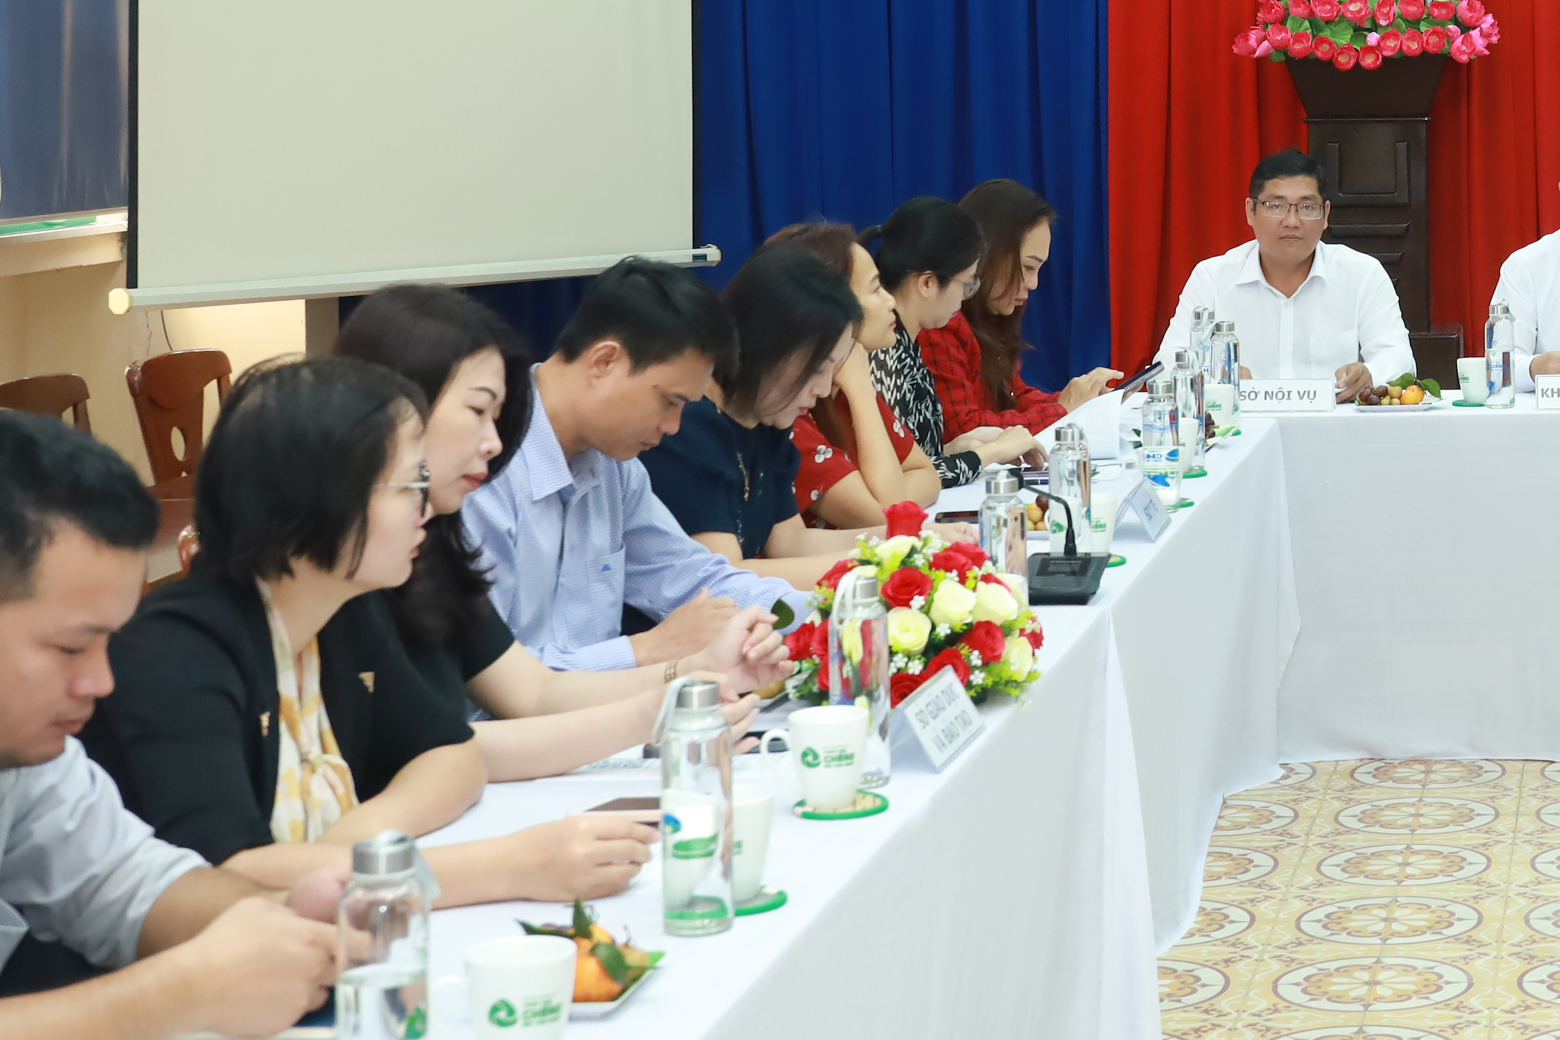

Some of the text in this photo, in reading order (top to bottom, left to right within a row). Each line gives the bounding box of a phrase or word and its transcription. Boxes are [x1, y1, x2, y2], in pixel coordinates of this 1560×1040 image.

[1239, 387, 1317, 404] SỞ NỘI VỤ
